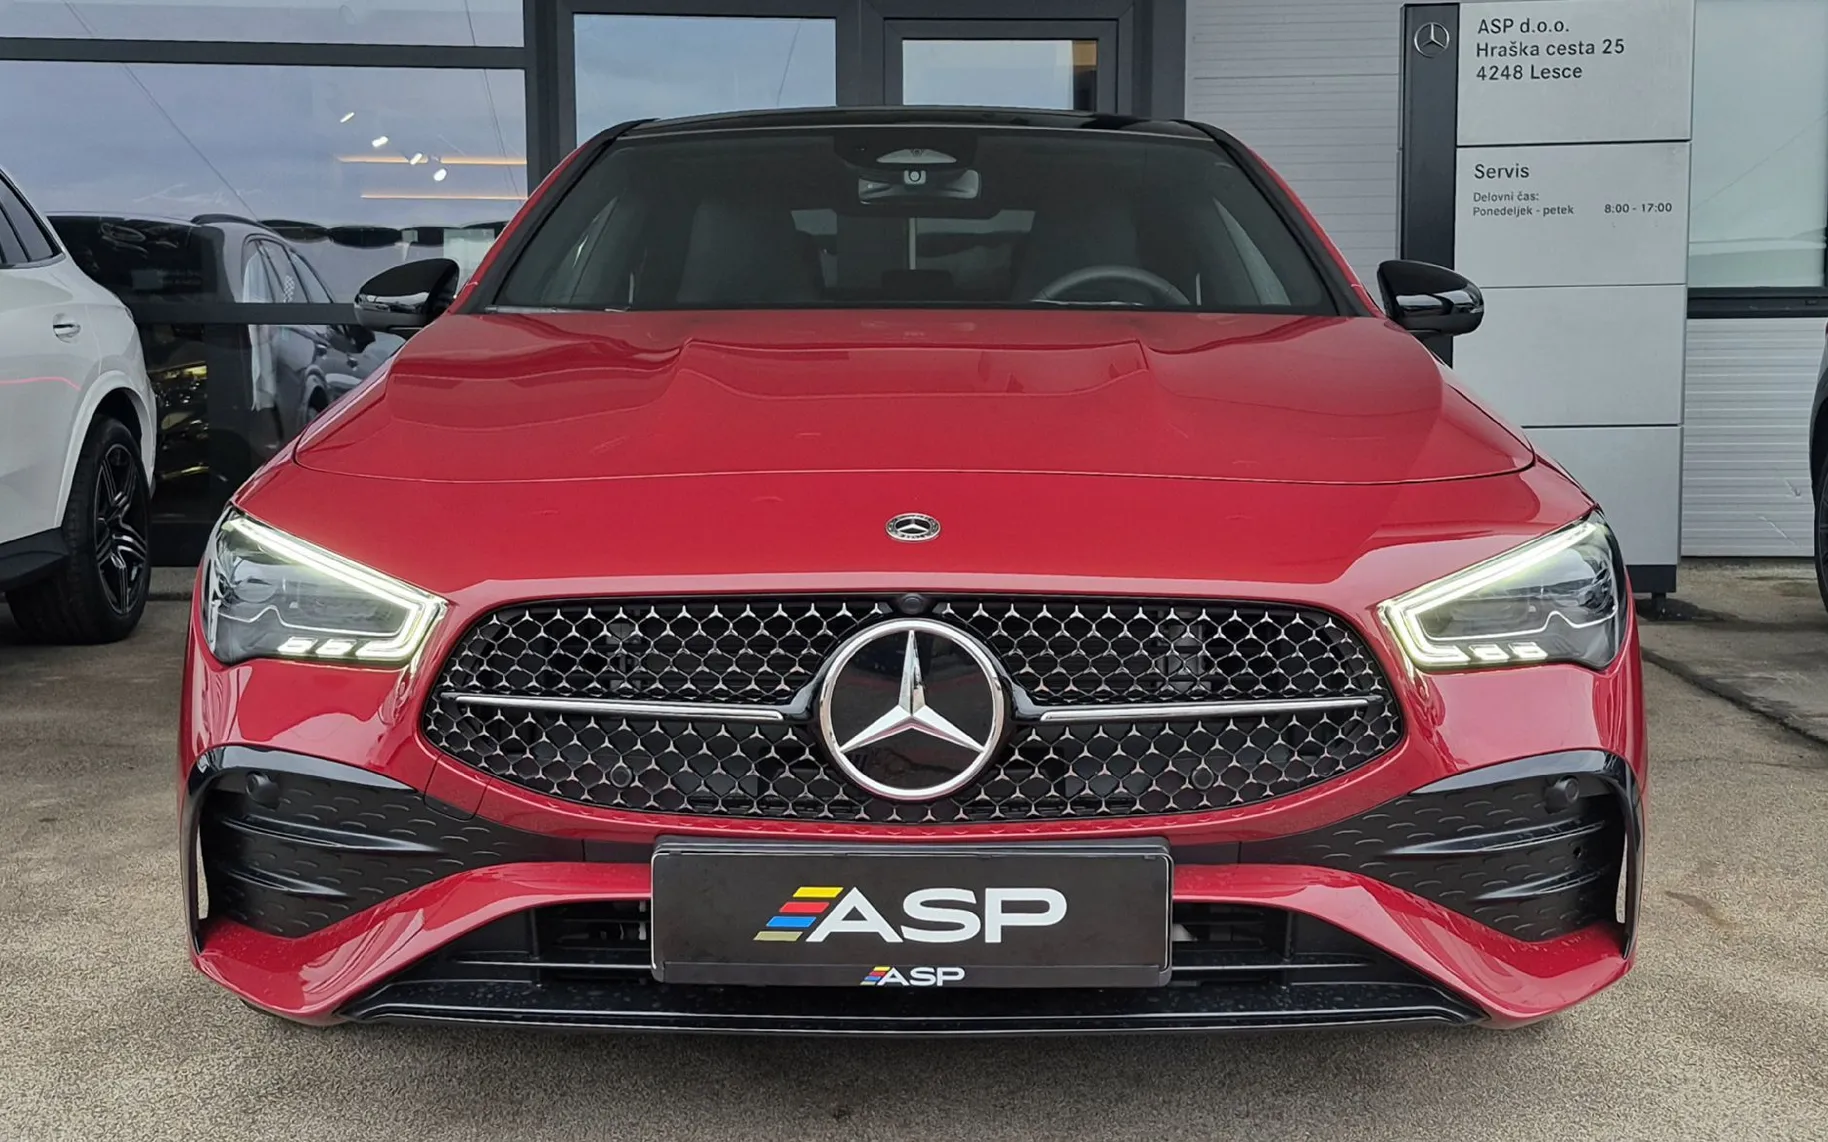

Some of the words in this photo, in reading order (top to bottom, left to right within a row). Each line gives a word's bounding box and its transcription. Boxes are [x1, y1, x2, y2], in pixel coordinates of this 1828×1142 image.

[1477, 18, 1514, 34] ASP
[1519, 18, 1569, 33] d.o.o.
[1476, 41, 1540, 58] Hraška
[1545, 41, 1595, 56] cesta
[1601, 38, 1625, 54] 25
[1476, 65, 1523, 80] 4248
[1530, 64, 1583, 80] Lesce
[1474, 163, 1530, 179] Servis
[1473, 191, 1514, 202] Delovni
[1516, 191, 1540, 202] čas:
[1473, 206, 1533, 217] Ponedeljek
[1543, 205, 1575, 217] petek
[1604, 203, 1630, 214] 8:00
[1641, 202, 1673, 213] 17:00
[806, 886, 1067, 943] ASP
[877, 966, 965, 986] ASP
